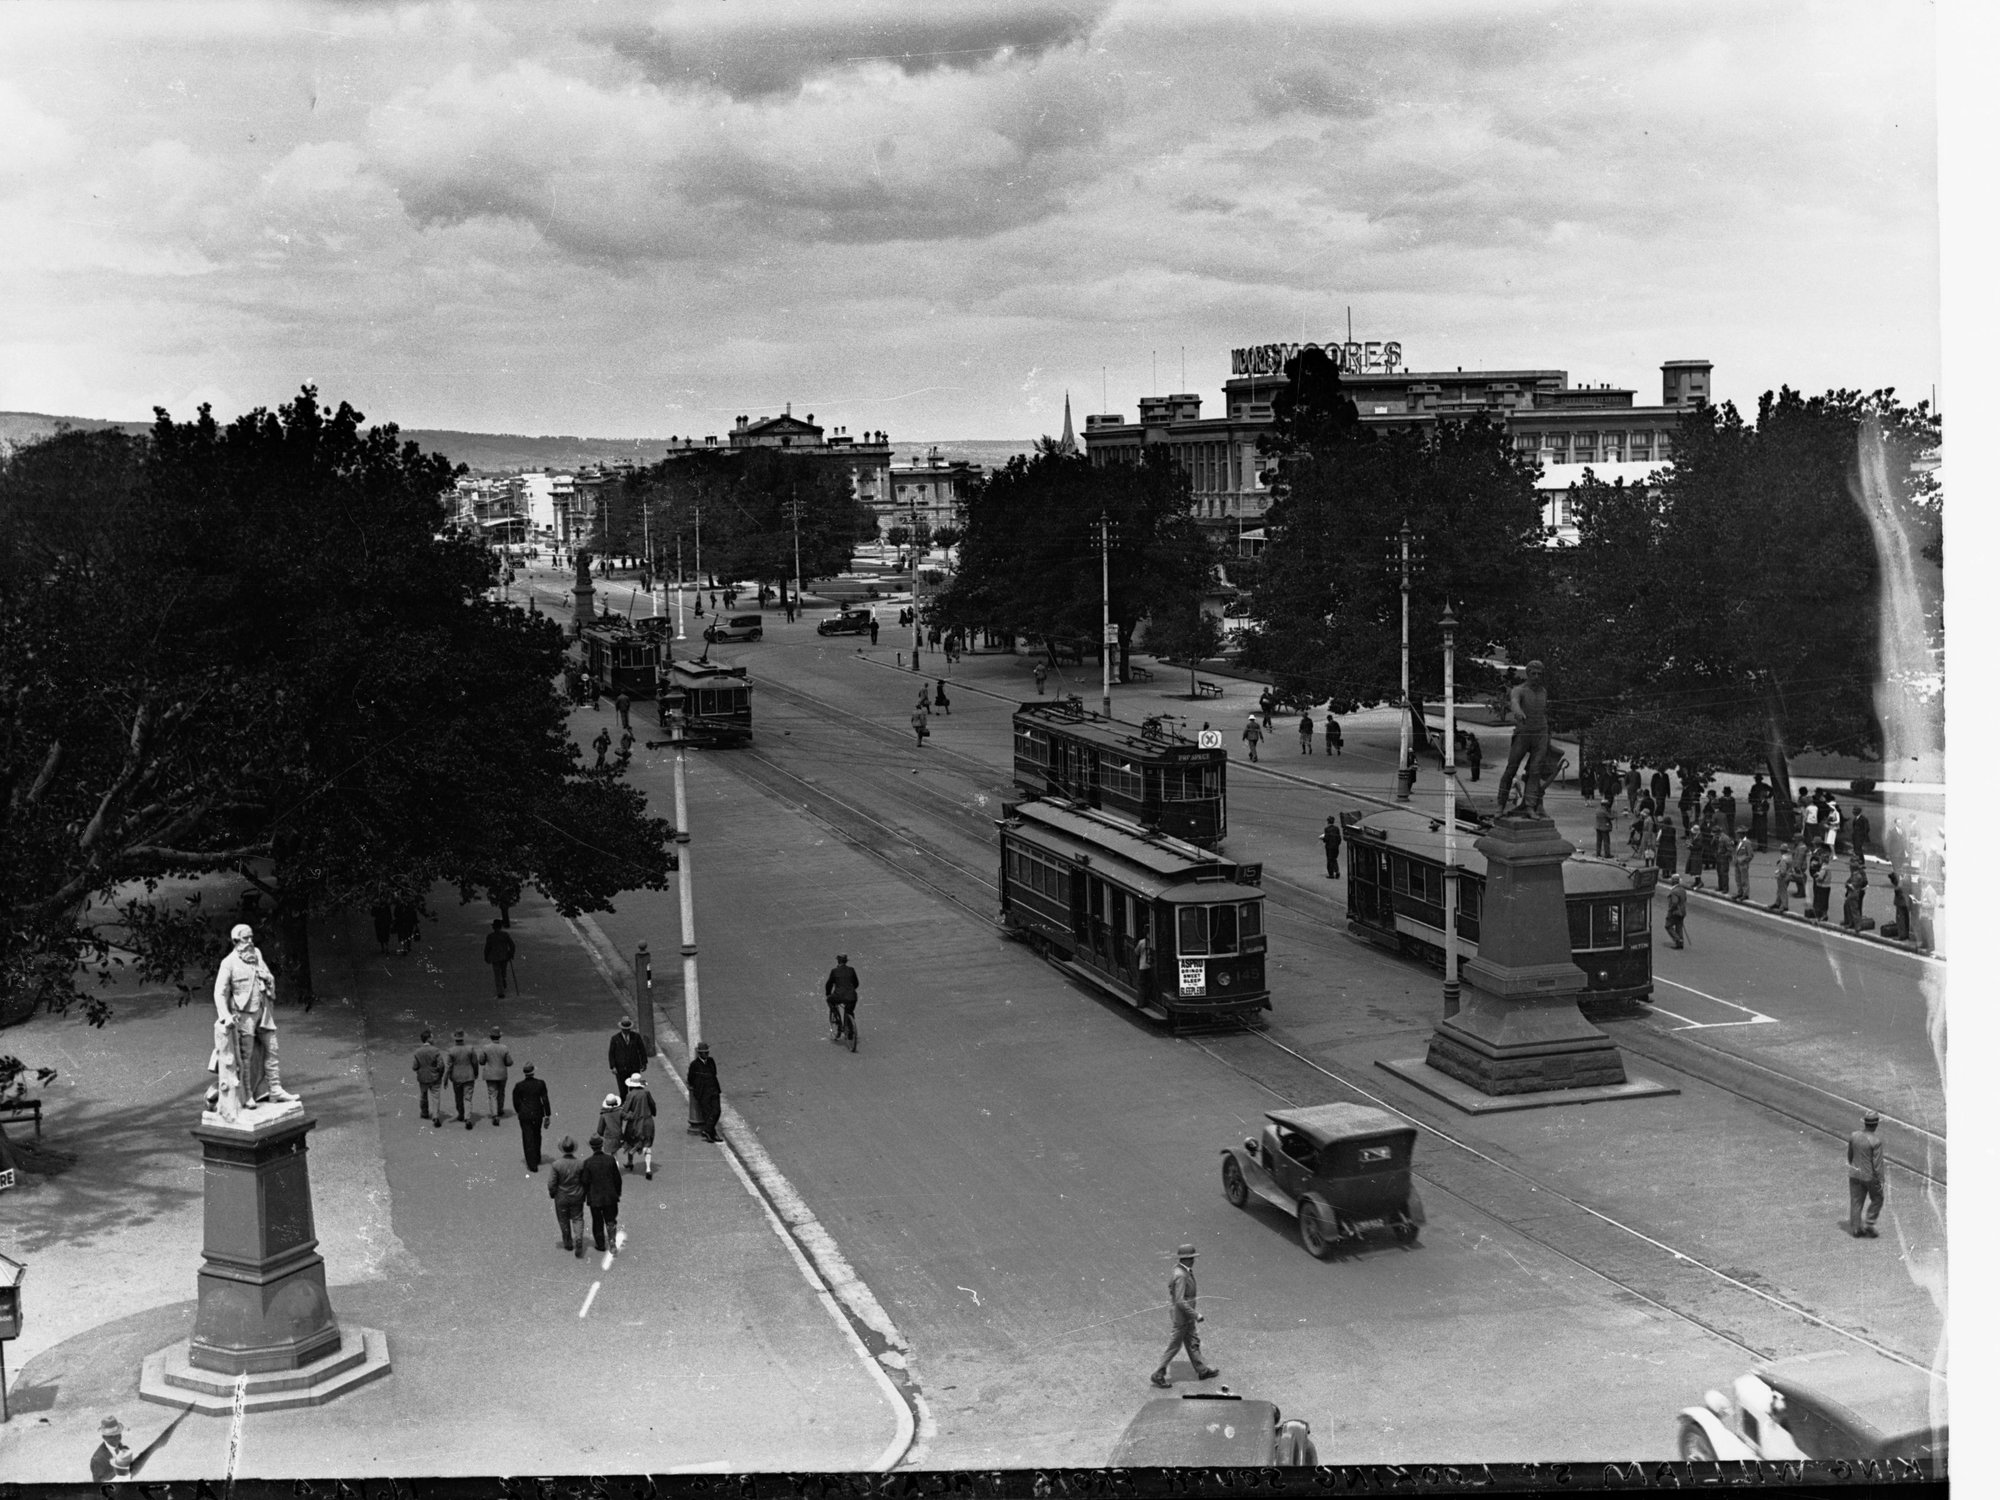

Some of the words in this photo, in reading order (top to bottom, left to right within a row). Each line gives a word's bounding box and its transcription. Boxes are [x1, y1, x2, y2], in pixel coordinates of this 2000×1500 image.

[1280, 341, 1402, 374] MORES
[1243, 867, 1257, 878] 15
[1181, 959, 1203, 968] ASPRO
